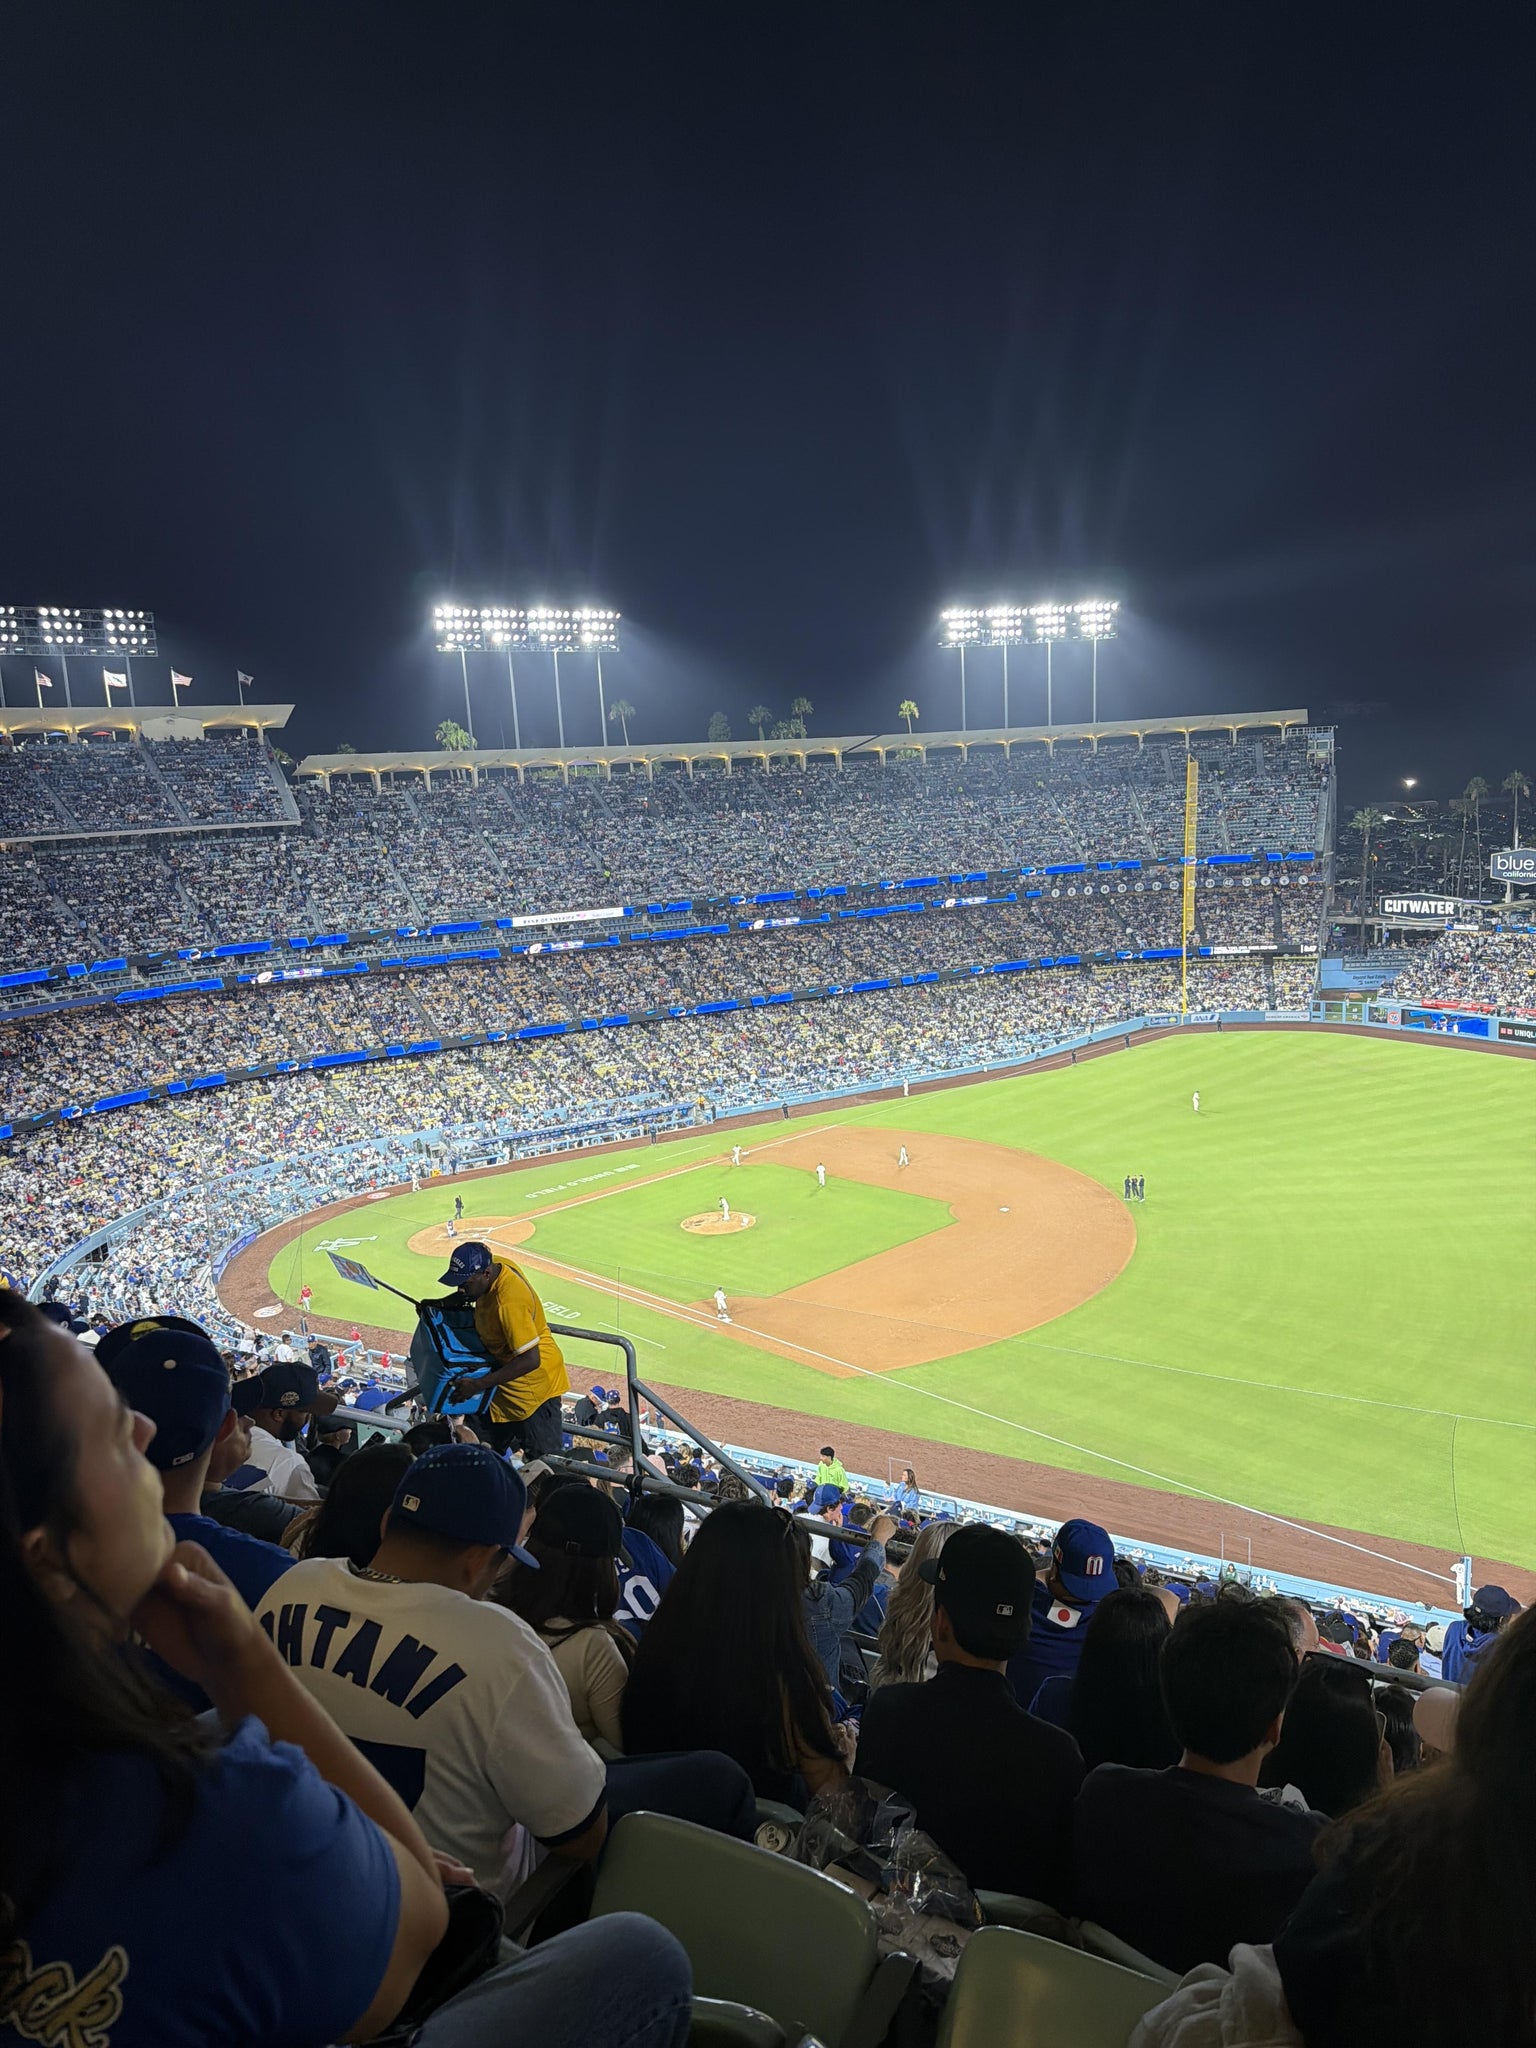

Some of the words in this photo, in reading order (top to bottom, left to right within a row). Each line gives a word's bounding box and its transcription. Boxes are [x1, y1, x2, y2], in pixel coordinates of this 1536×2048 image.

[1497, 855, 1535, 871] blue
[1384, 899, 1455, 915] CUTWATER
[1514, 1029, 1536, 1039] UNIQL
[543, 1301, 581, 1319] FIELD
[612, 1575, 661, 1621] 0
